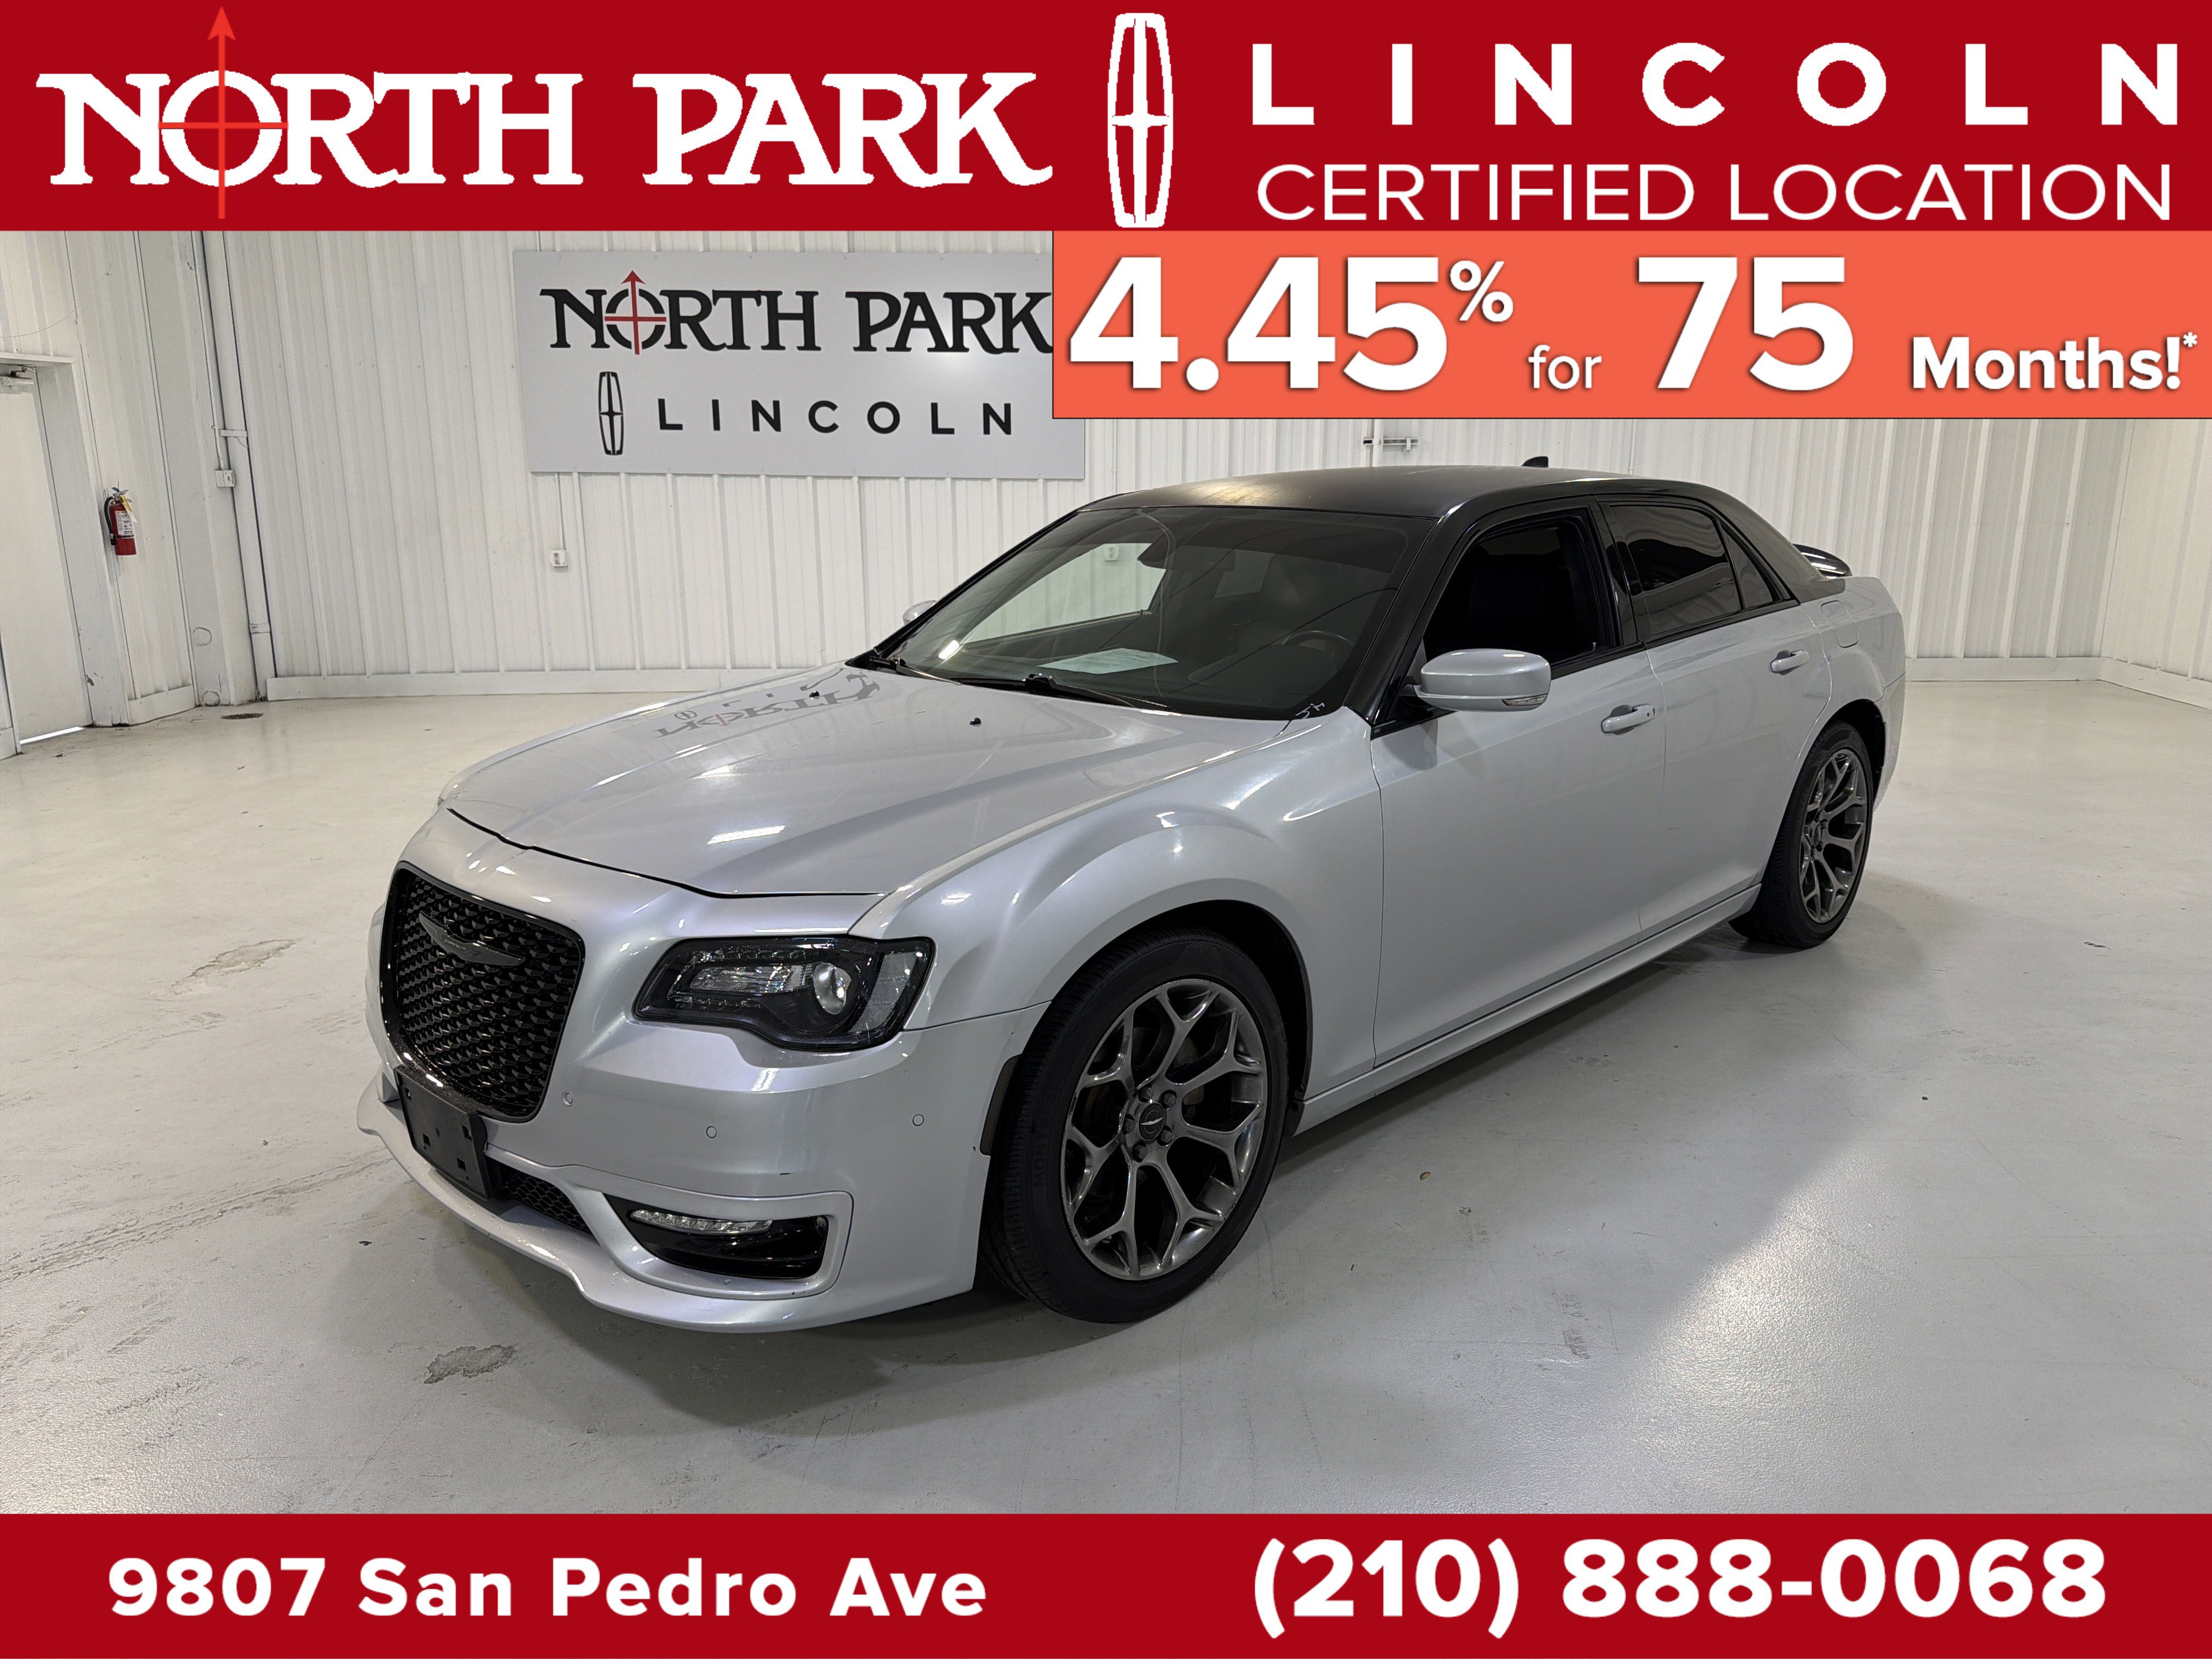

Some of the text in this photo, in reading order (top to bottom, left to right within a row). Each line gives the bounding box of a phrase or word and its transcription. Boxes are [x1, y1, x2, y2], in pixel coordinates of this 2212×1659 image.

[539, 287, 1053, 355] NORTH PARK
[657, 398, 1012, 436] LINCOLN
